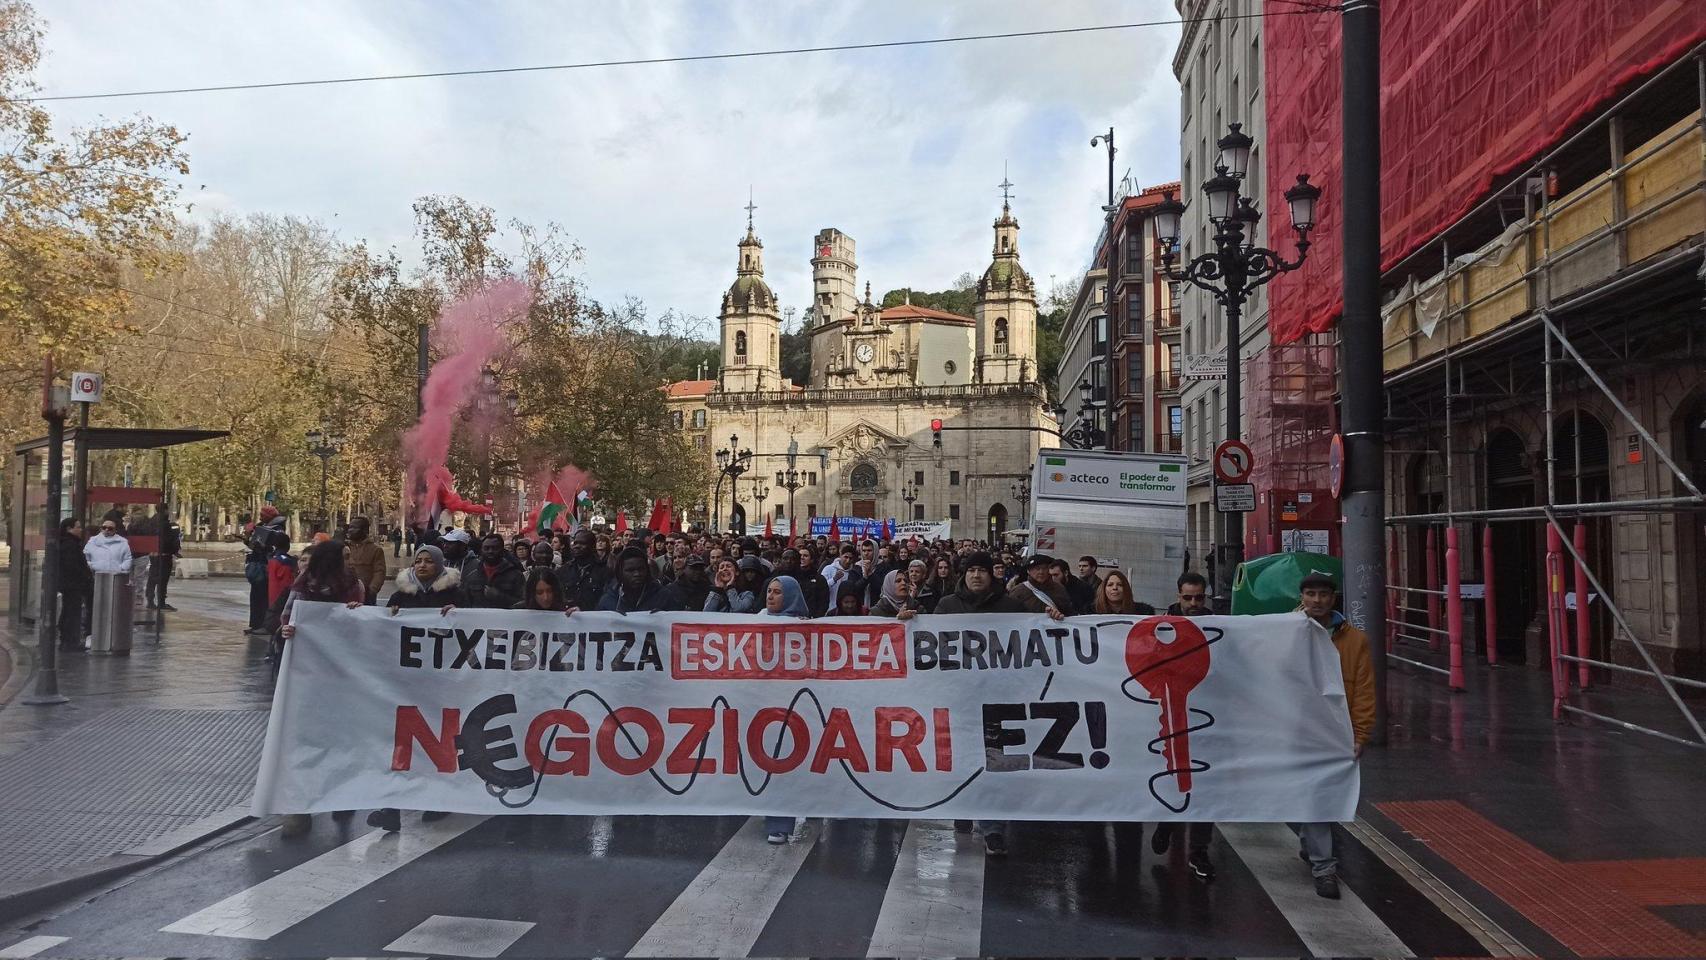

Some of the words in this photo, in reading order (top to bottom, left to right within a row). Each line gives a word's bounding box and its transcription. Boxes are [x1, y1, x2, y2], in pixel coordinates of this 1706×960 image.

[1070, 473, 1109, 484] acteco
[1120, 472, 1127, 480] El
[1129, 473, 1156, 482] poder
[1157, 474, 1169, 482] de
[1119, 481, 1177, 491] transformar
[400, 625, 664, 672] ETXEBIZITZA
[679, 631, 900, 672] ESKUBIDEA
[912, 626, 1099, 671] BERMATU
[981, 701, 1111, 773] EZ!
